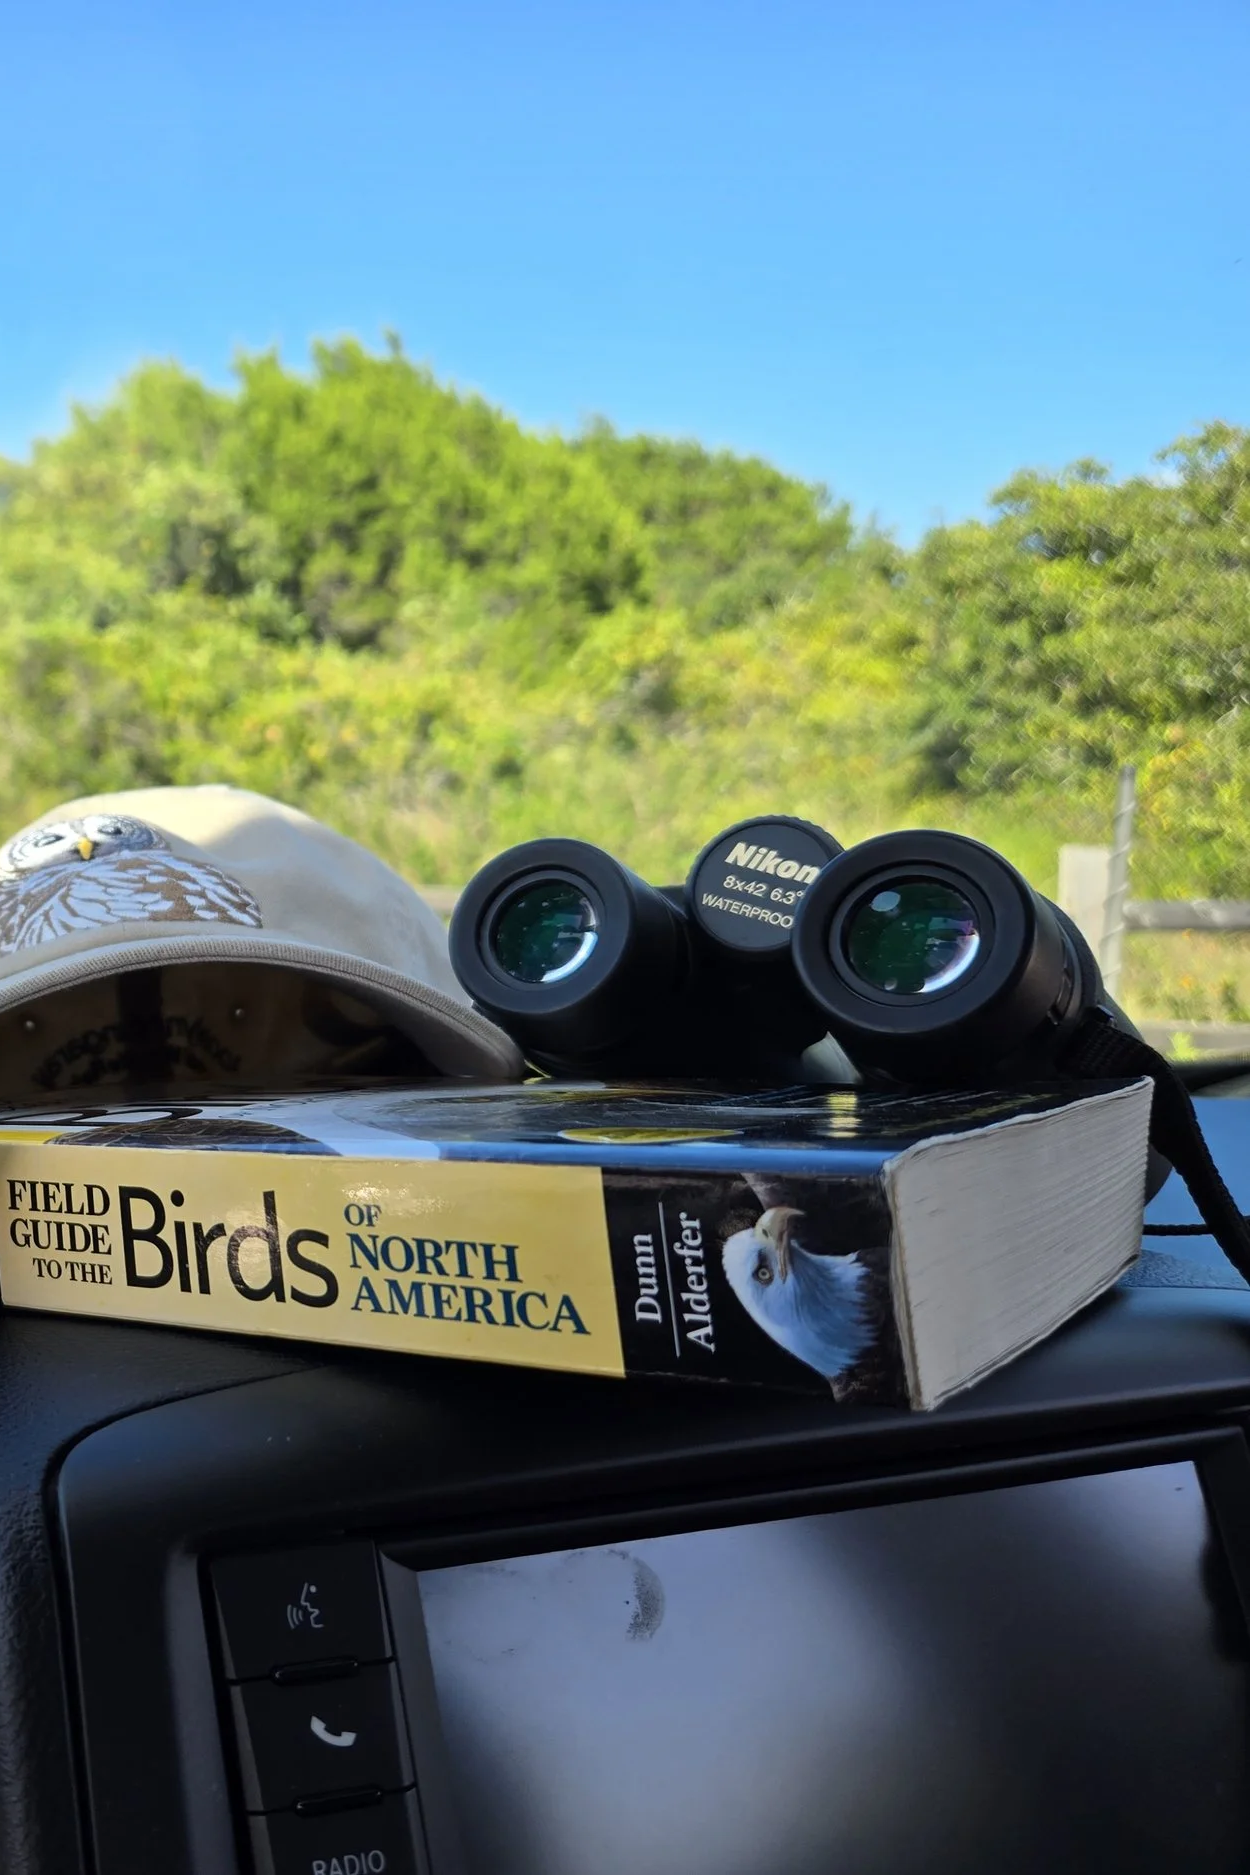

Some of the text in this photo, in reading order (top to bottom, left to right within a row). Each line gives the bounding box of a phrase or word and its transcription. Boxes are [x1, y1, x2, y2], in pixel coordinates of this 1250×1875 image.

[724, 842, 822, 885] Nikon
[723, 875, 767, 898] 8x42
[701, 893, 794, 929] WATERPROO
[6, 1179, 111, 1217] FIELD
[344, 1203, 383, 1228] OF
[9, 1218, 113, 1256] GUIDE
[118, 1185, 340, 1308] Birds
[32, 1257, 113, 1285] TO THE
[346, 1233, 523, 1284] NORTH
[634, 1233, 662, 1324] Dunn
[674, 1211, 717, 1355] Alderfer
[351, 1276, 592, 1336] AMERICA
[311, 1850, 386, 1875] RADIO
